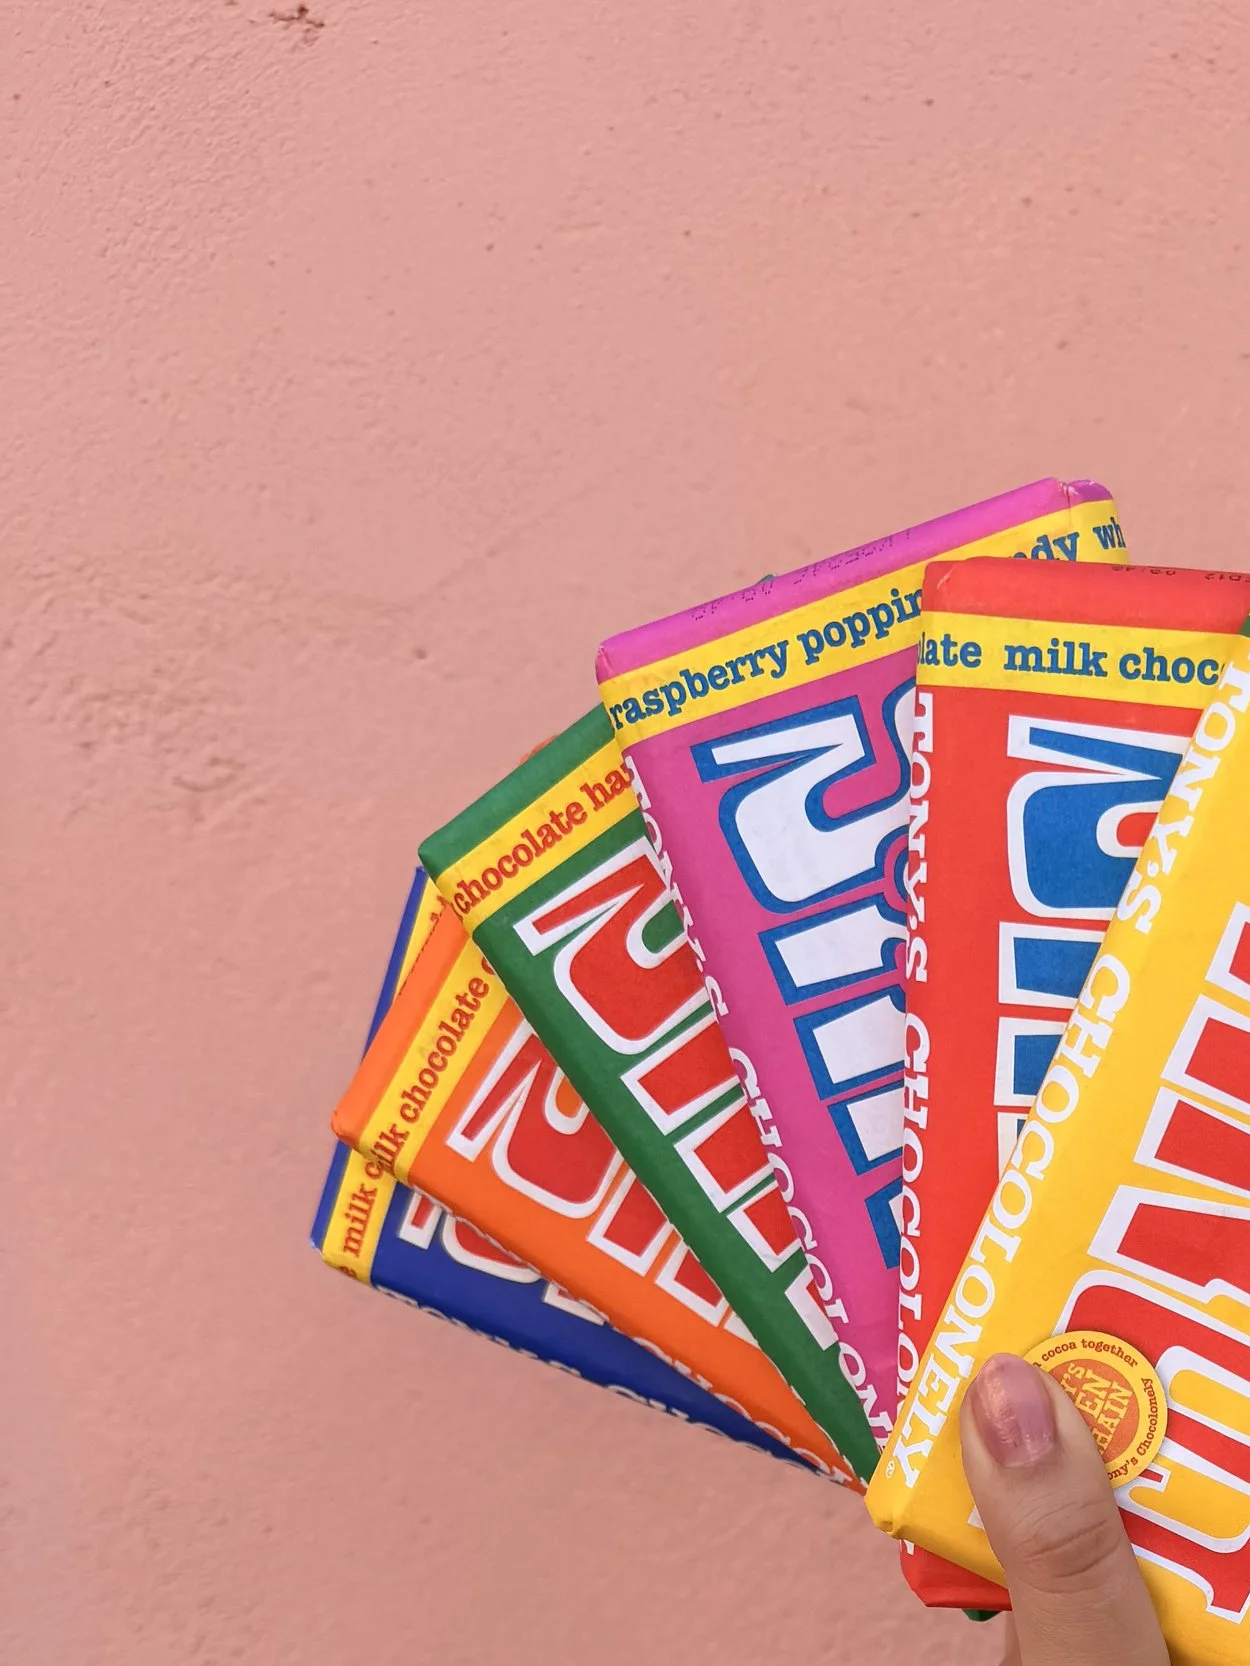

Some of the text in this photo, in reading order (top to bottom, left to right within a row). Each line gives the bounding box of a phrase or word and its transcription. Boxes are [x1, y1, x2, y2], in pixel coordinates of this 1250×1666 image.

[610, 588, 923, 731] raspberry poppin
[917, 632, 1225, 686] late milk choc
[453, 801, 588, 914] chocolate
[400, 977, 490, 1124] chocolate
[343, 1183, 378, 1257] milk
[1041, 1338, 1138, 1368] cocoa together
[1075, 1368, 1112, 1419] EN
[1091, 1382, 1133, 1455] HAIN
[1107, 1377, 1159, 1481] ony's Chocolonely
